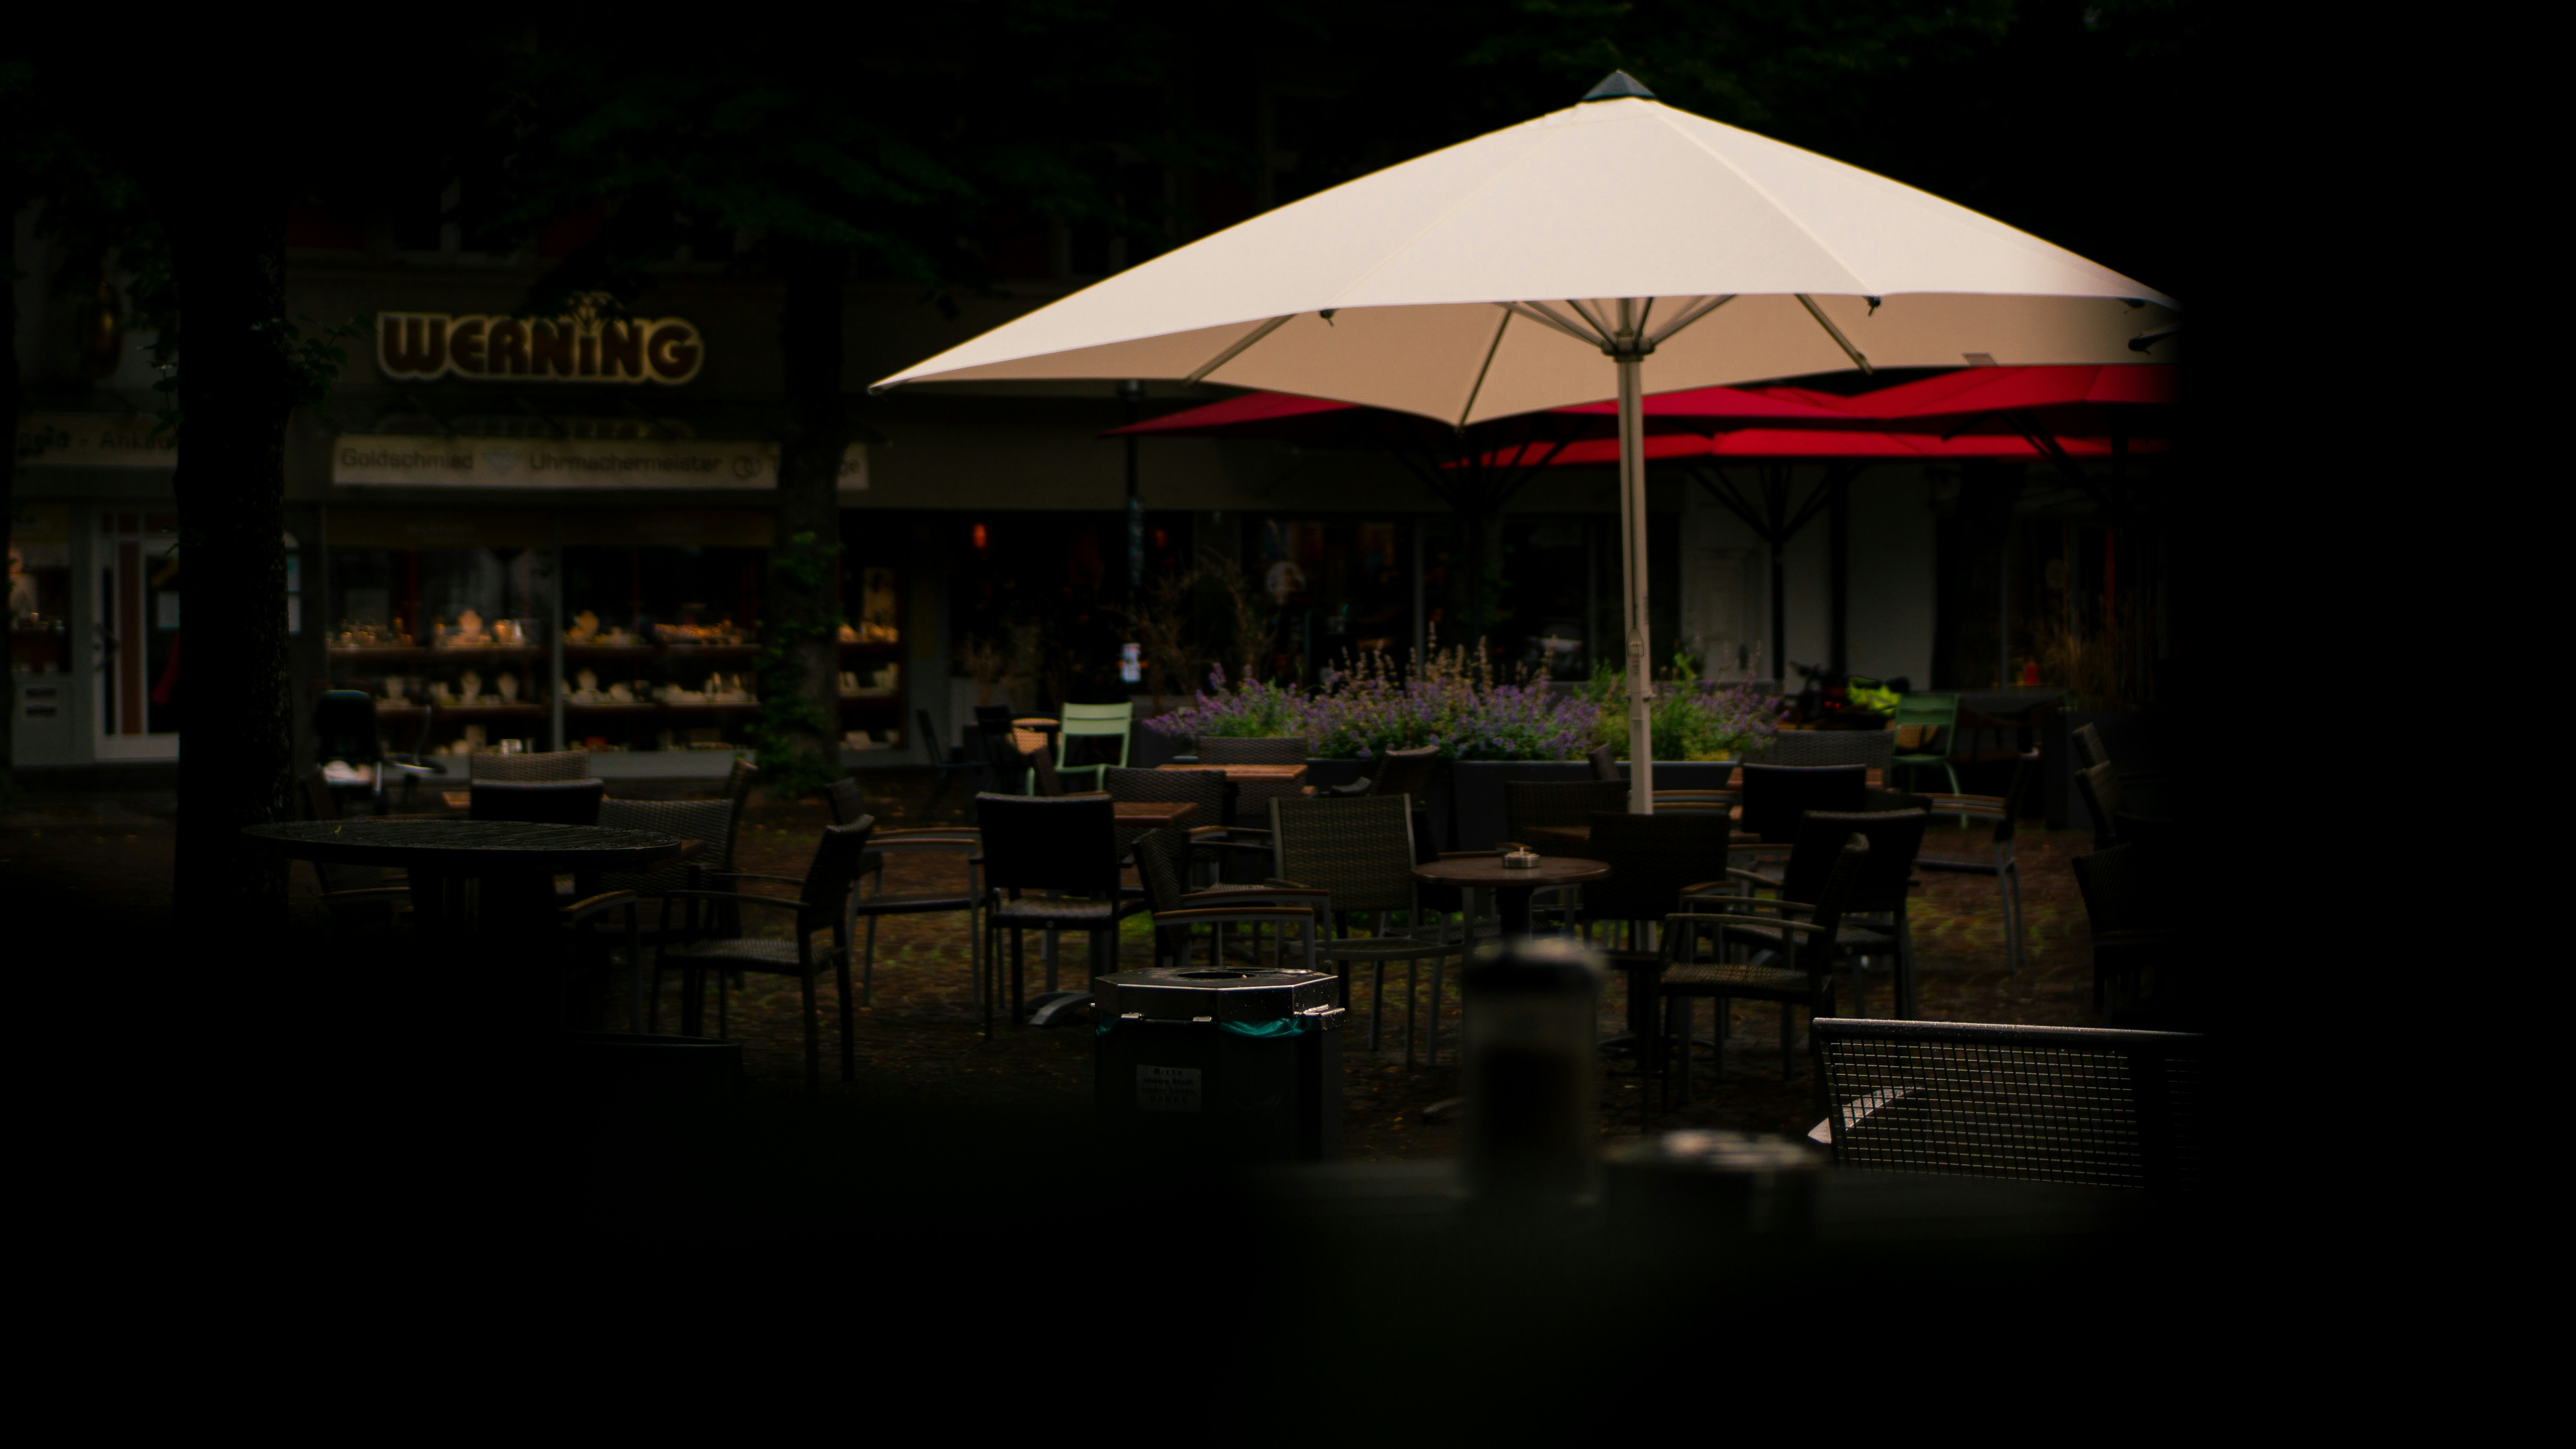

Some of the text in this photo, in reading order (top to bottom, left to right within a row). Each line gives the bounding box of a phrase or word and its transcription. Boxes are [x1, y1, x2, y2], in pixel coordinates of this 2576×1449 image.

[342, 448, 722, 472] Goldschmied Uhrmachermeister
[1150, 1095, 1188, 1103] DANKE
